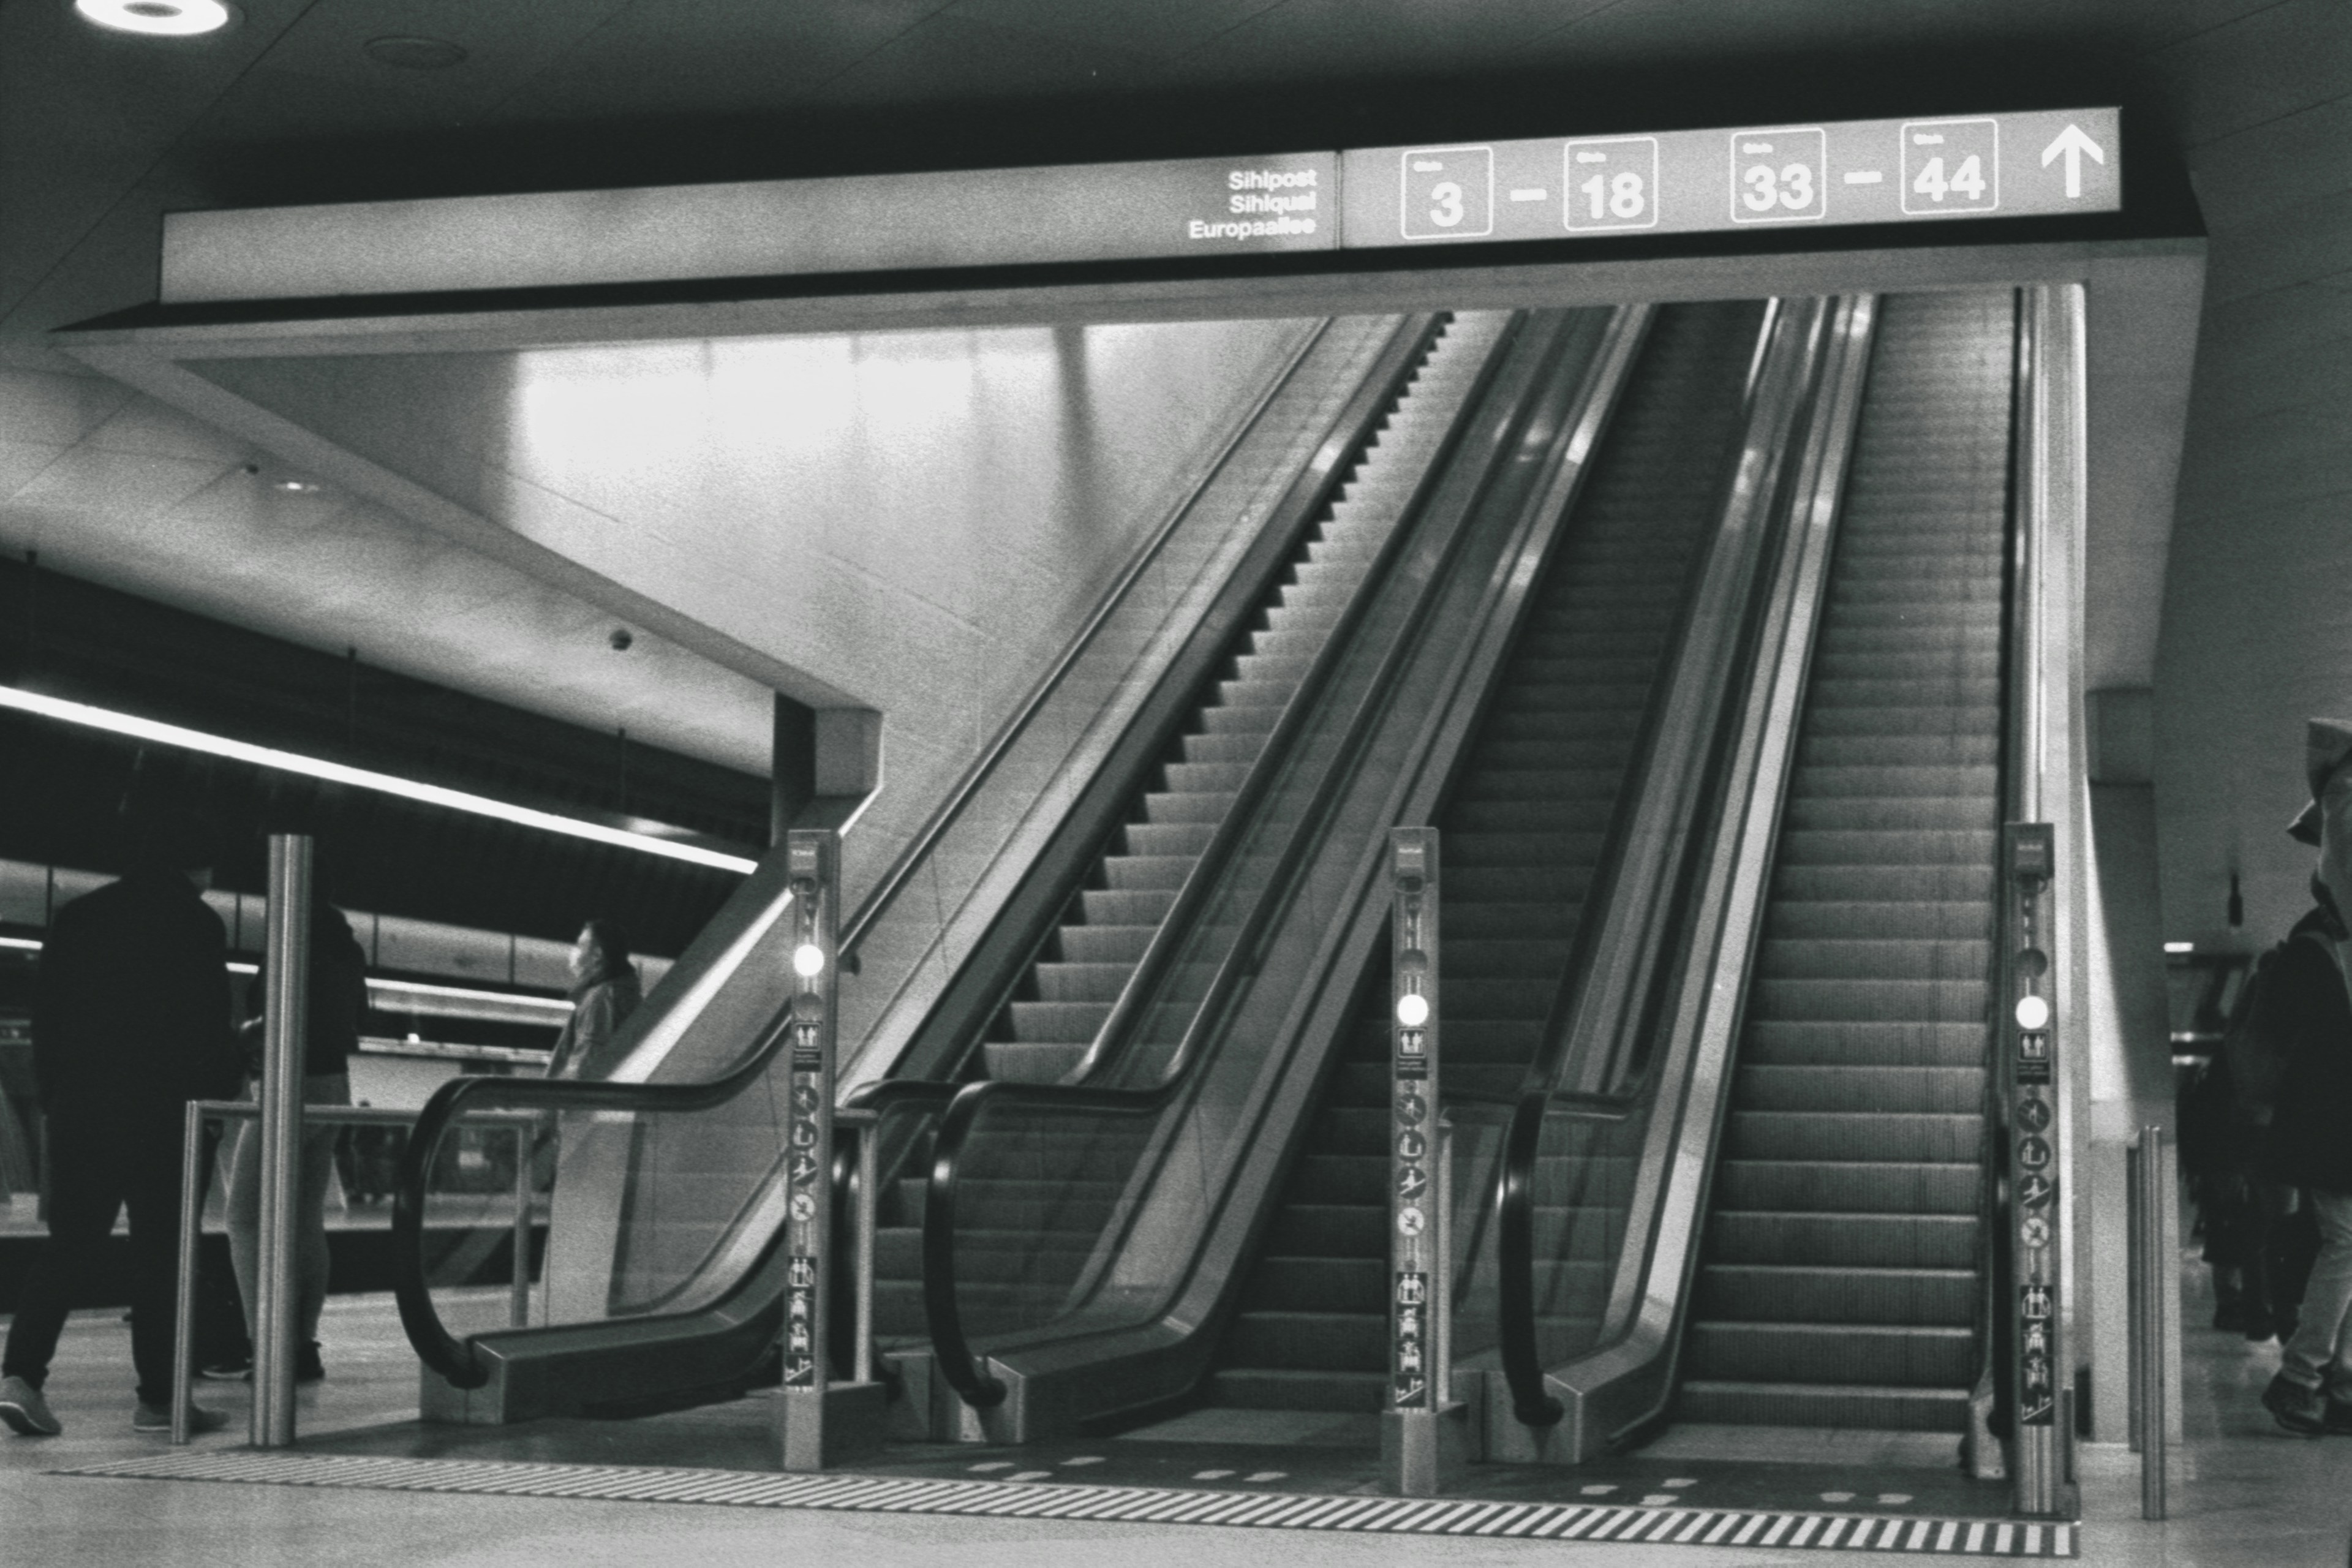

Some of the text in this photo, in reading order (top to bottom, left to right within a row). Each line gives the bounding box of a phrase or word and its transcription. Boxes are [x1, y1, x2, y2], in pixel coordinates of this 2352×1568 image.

[1229, 169, 1317, 191] Sihlpost
[1430, 182, 1464, 227] 3
[1581, 172, 1645, 219] 18
[1742, 163, 1814, 211] 33
[1913, 155, 1986, 202] 44
[1189, 216, 1316, 239] Europaallee
